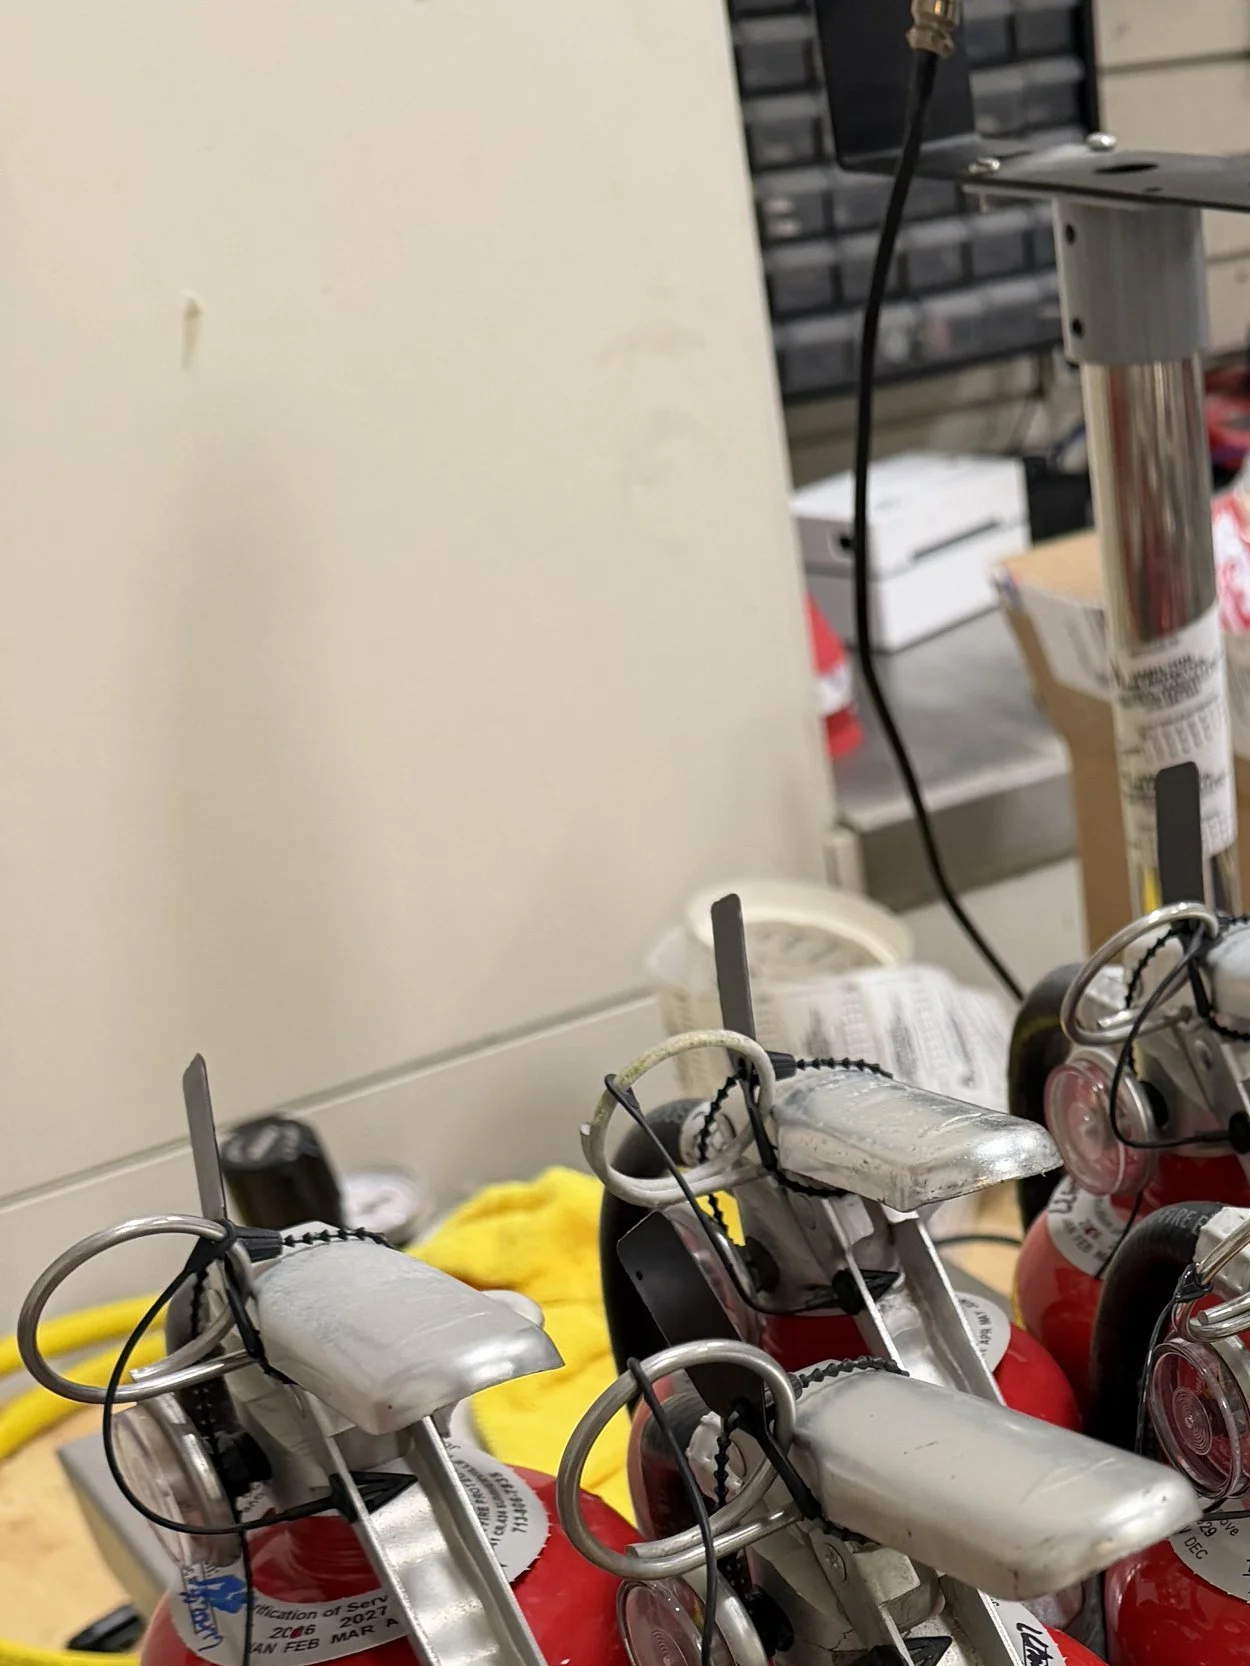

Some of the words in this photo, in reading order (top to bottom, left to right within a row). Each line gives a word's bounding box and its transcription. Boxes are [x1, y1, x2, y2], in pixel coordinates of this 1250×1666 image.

[1184, 1536, 1209, 1561] DEC
[250, 1603, 322, 1621] rification
[324, 1604, 340, 1617] of
[346, 1595, 389, 1613] Serv
[340, 1606, 388, 1629] 2027
[284, 1638, 319, 1653] FEB
[330, 1625, 375, 1645] MAR
